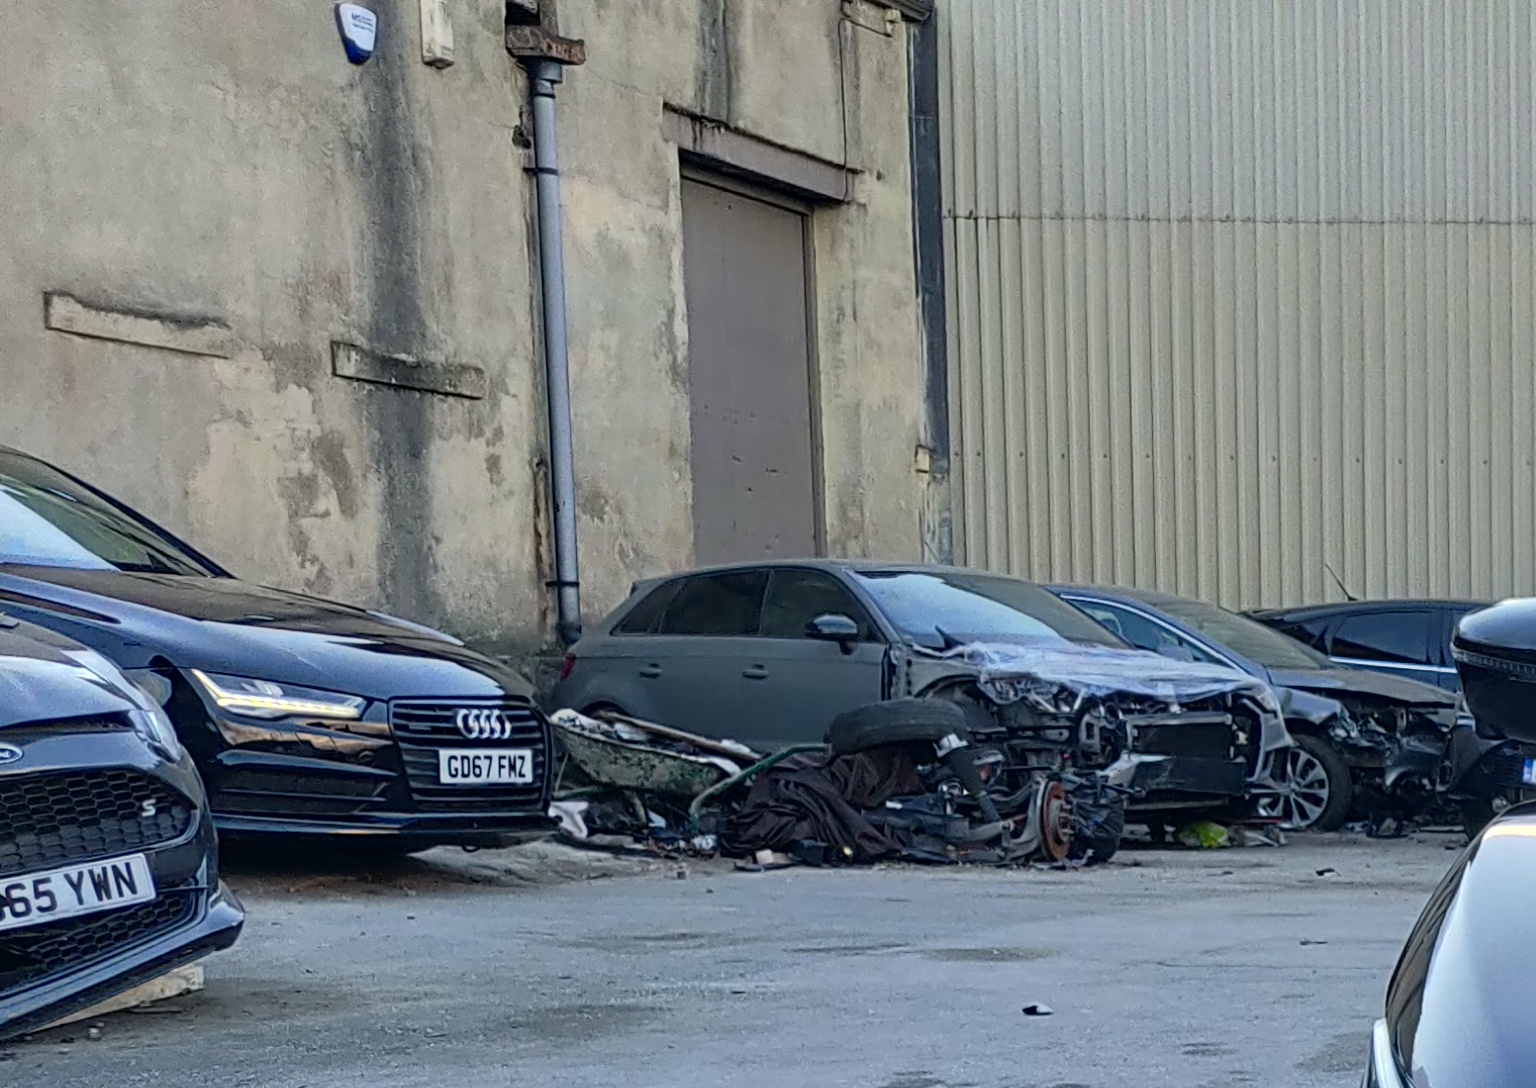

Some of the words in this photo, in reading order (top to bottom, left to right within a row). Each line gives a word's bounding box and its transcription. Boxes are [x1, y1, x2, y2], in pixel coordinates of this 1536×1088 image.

[447, 755, 493, 779] GD67
[0, 876, 58, 922] 65
[63, 861, 139, 907] YWN
